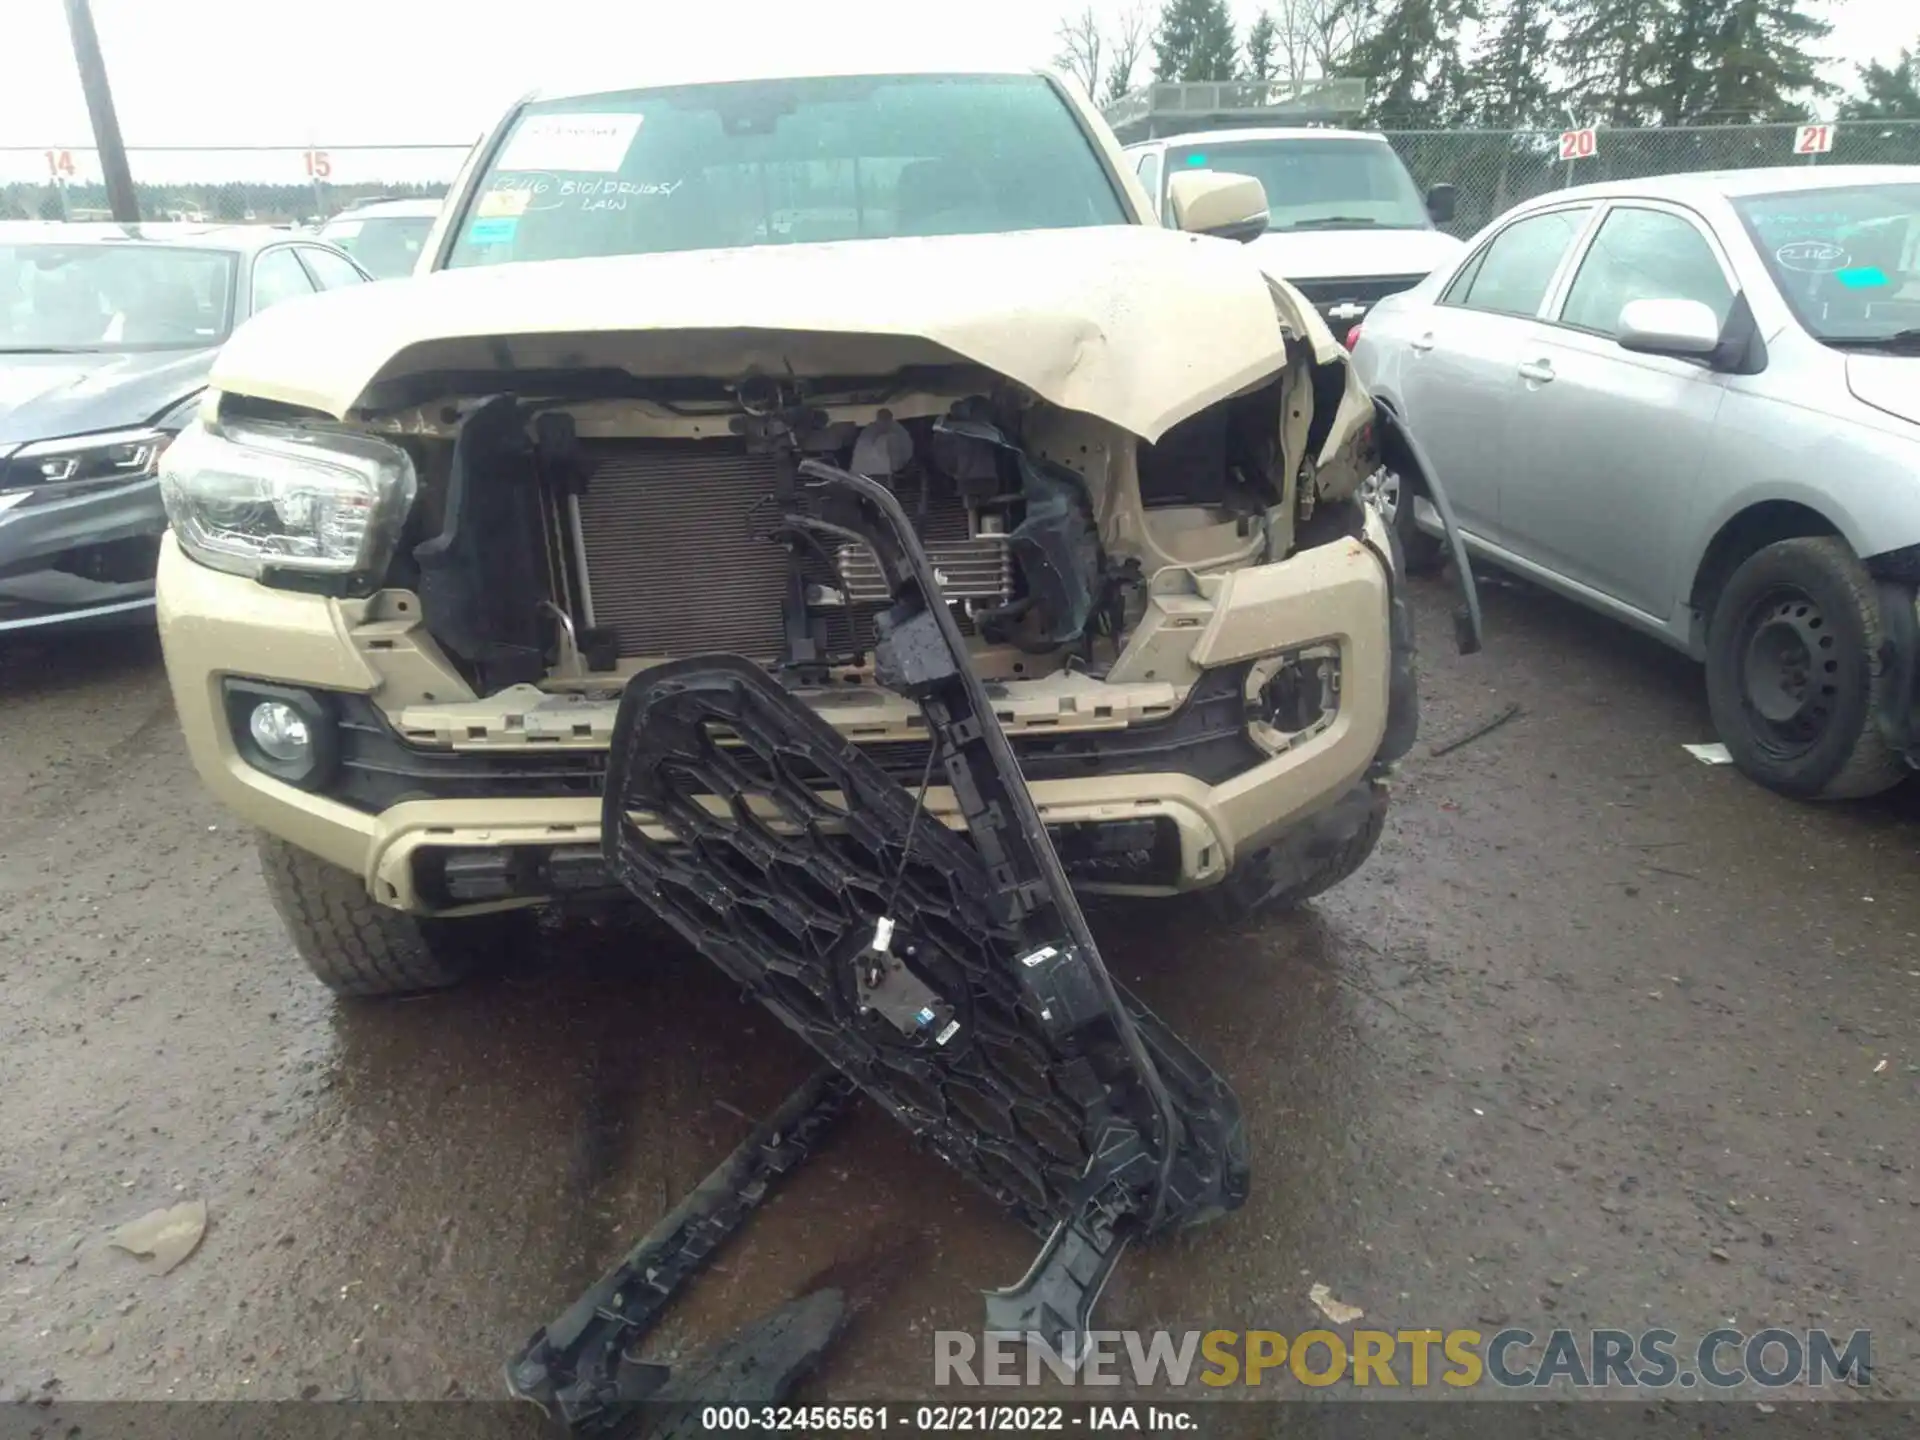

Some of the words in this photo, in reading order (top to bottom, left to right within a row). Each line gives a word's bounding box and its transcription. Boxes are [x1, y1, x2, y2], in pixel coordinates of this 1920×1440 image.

[1562, 130, 1593, 157] 20
[1800, 127, 1827, 152] 21
[44, 150, 76, 176] 14
[303, 151, 331, 177] 15
[581, 198, 628, 212] LAW
